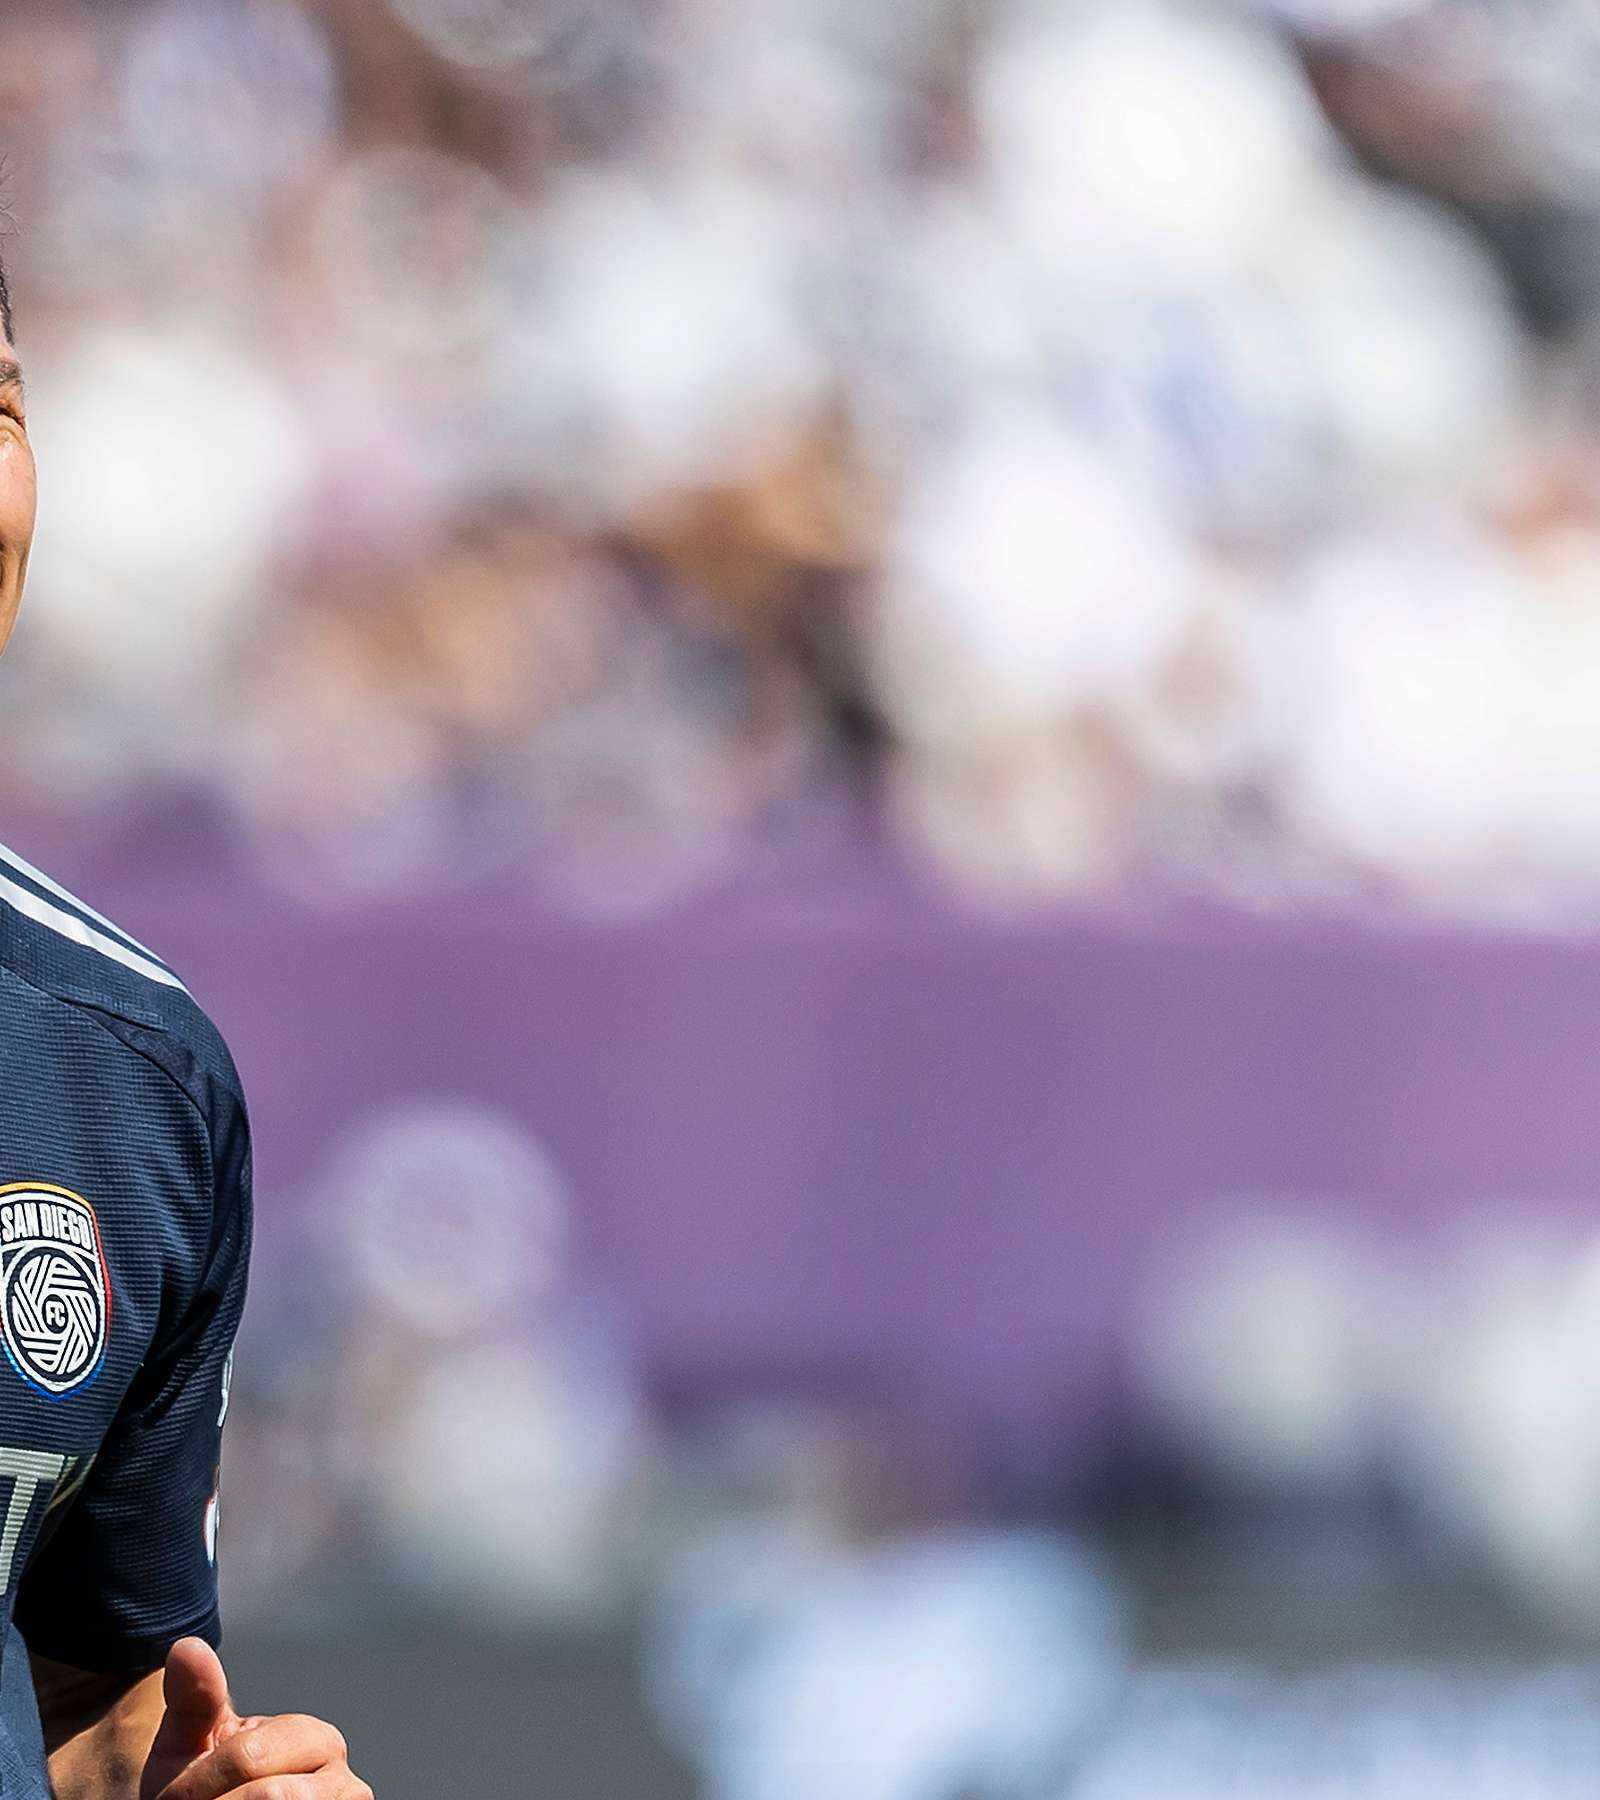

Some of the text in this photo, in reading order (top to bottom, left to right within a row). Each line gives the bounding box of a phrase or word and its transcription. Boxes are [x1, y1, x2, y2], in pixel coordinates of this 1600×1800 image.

[0, 1202, 93, 1250] SAN DIEGO
[45, 1300, 66, 1327] FC
